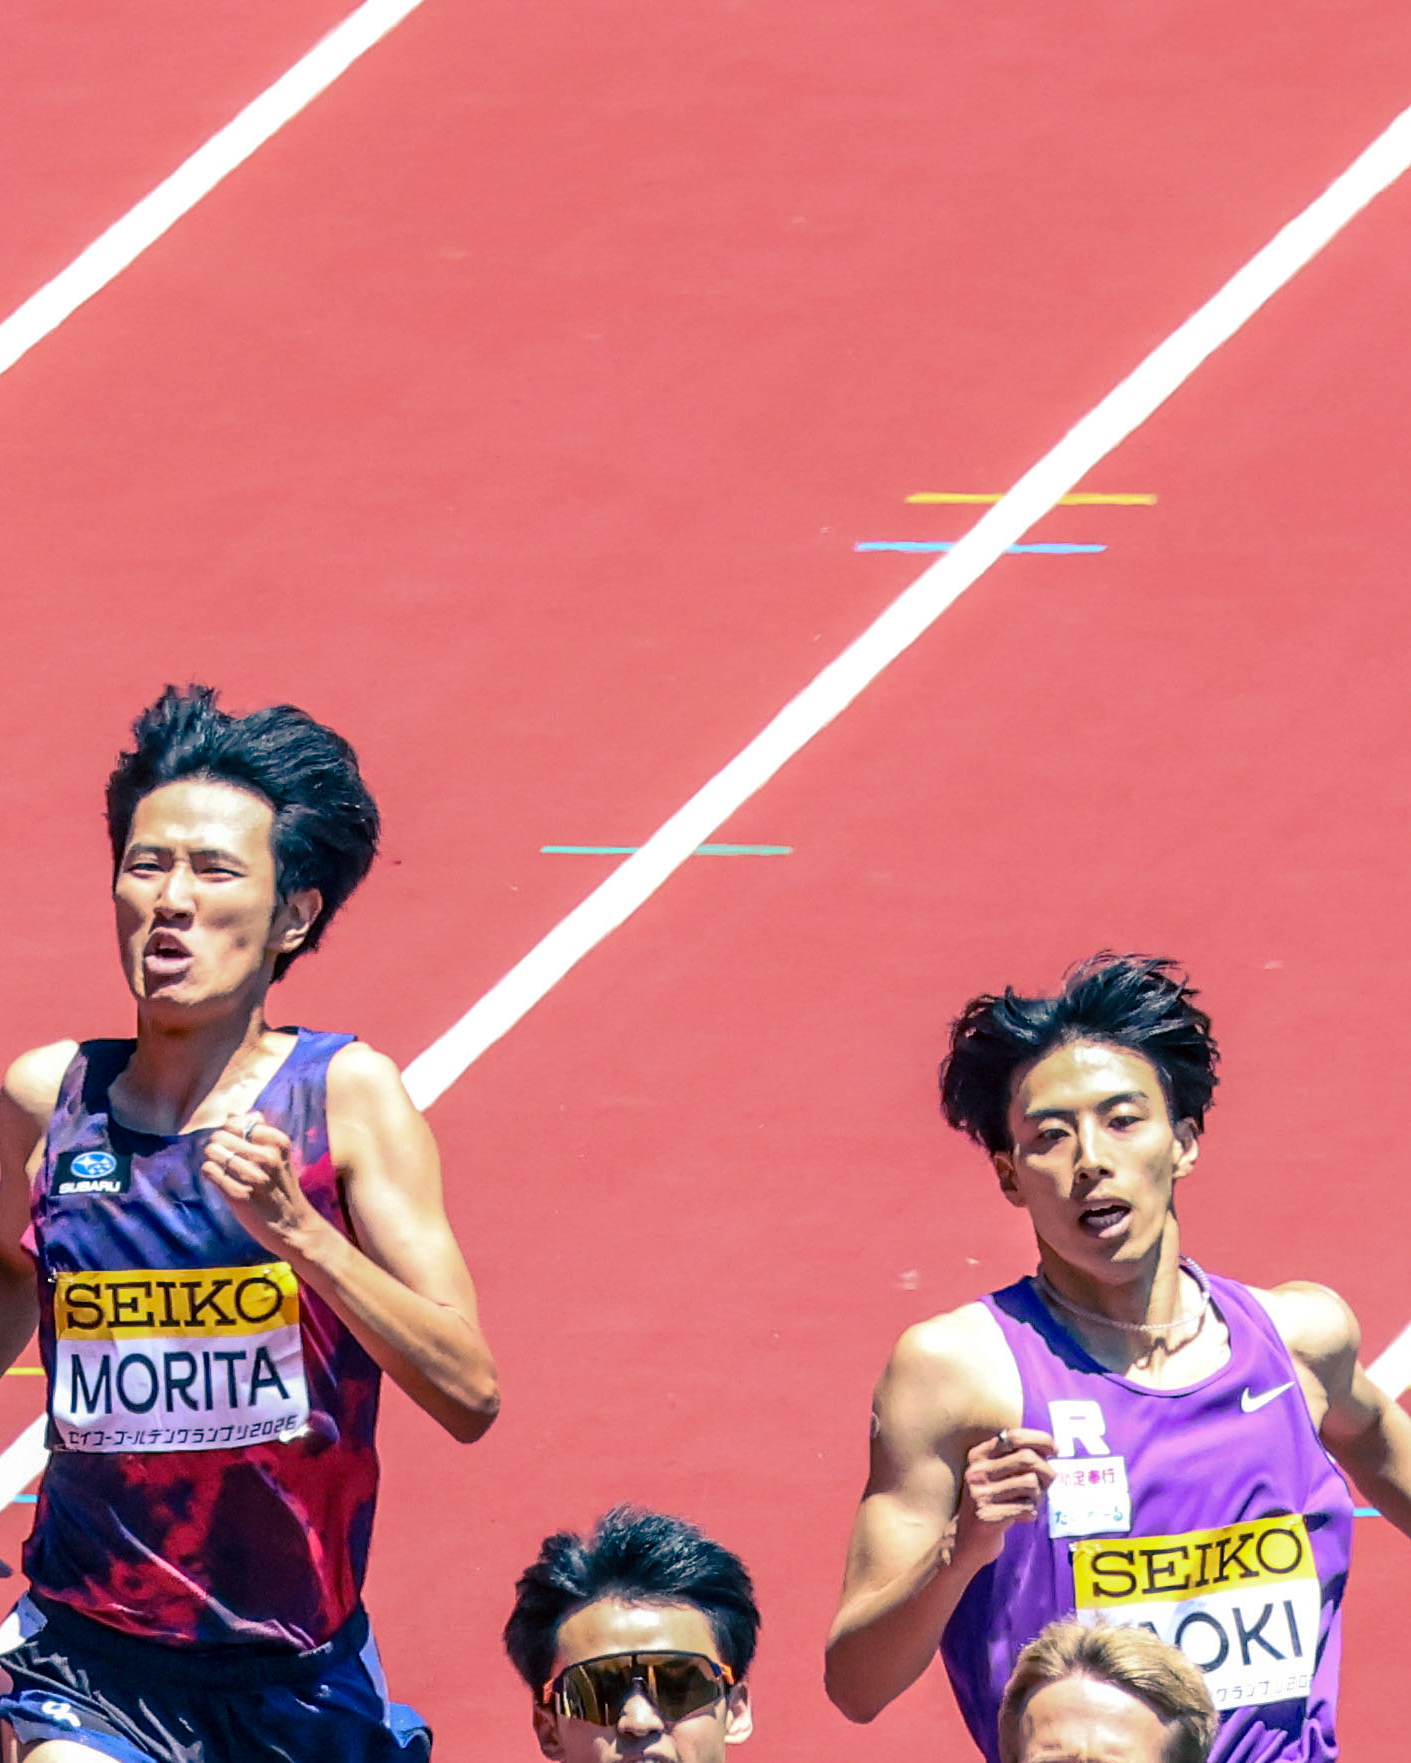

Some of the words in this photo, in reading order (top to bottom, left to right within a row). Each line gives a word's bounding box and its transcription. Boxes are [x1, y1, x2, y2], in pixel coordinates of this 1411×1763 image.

[58, 1181, 121, 1194] SUBARU
[65, 1277, 283, 1330] SEIKO
[70, 1346, 290, 1415] MORITA
[1048, 1400, 1111, 1458] R
[1091, 1528, 1302, 1598] SEIKO
[1139, 1600, 1303, 1674] OKI
